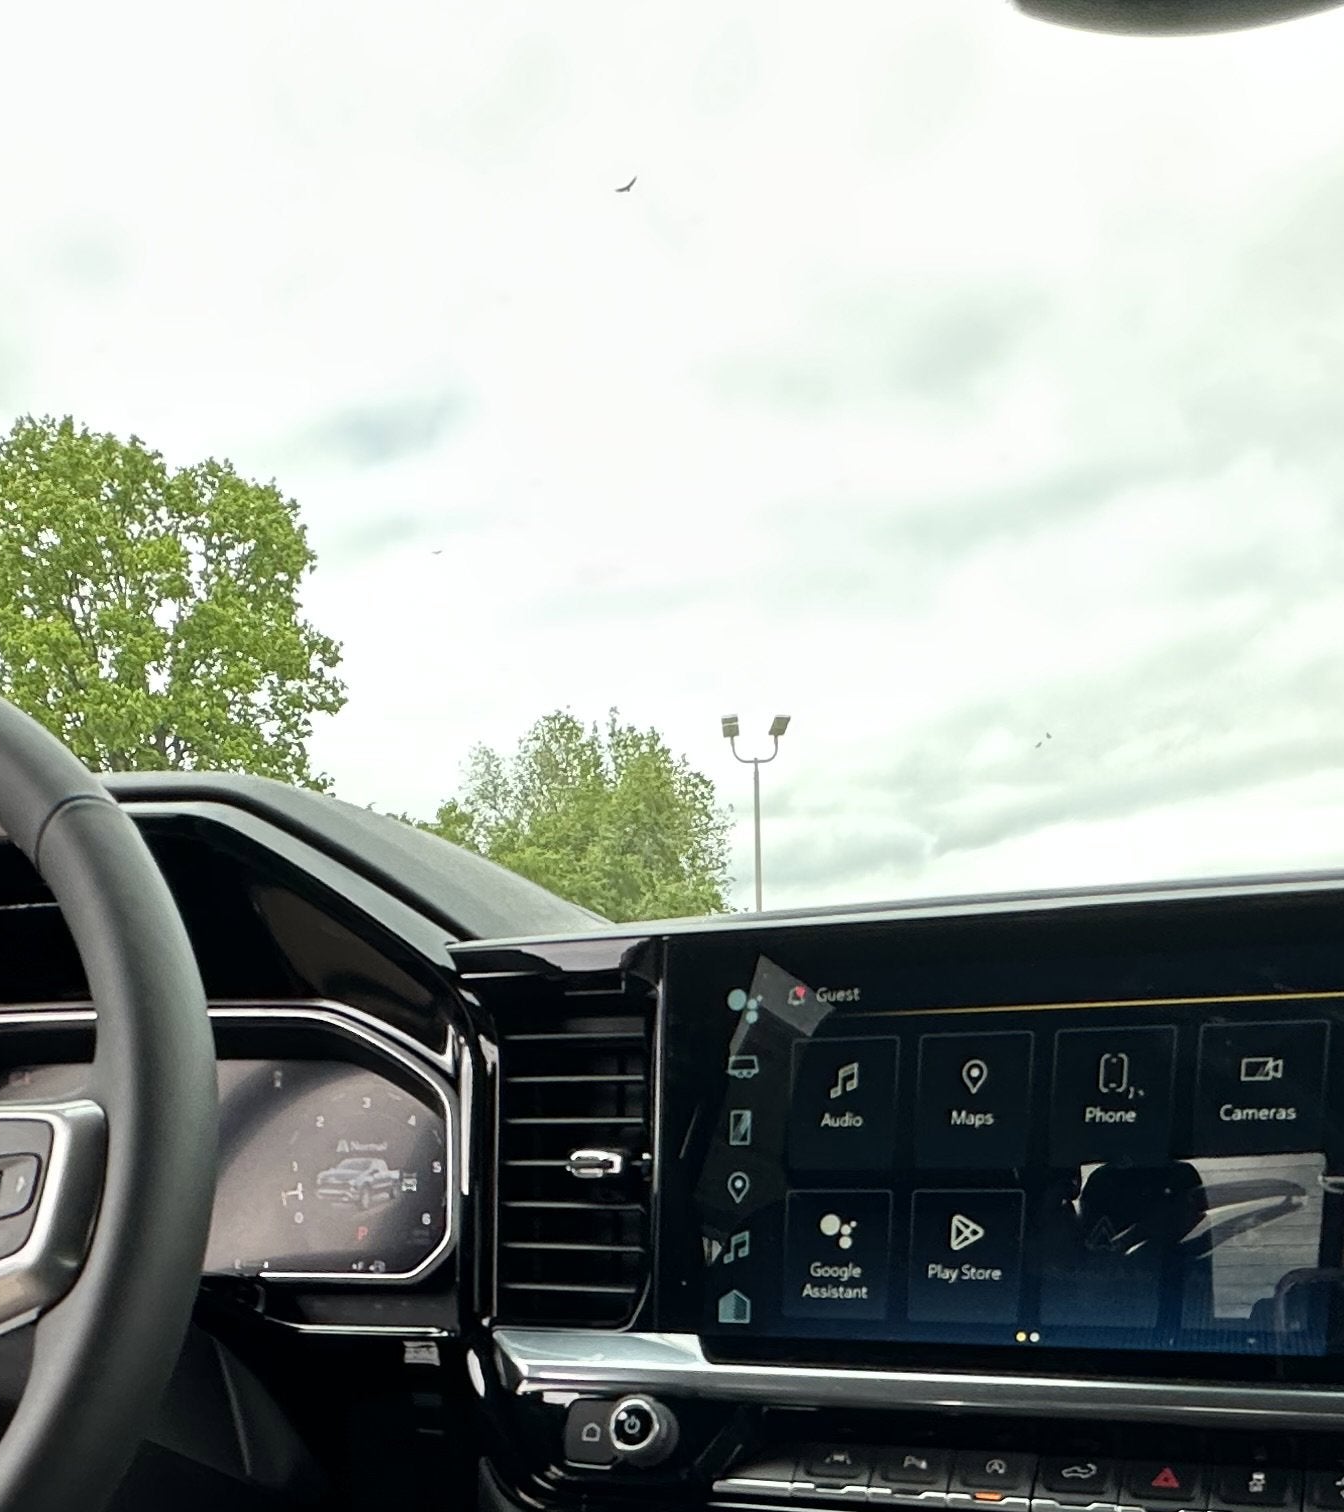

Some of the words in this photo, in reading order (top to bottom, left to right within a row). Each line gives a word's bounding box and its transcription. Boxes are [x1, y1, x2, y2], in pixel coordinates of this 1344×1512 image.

[815, 986, 861, 1003] Guest
[820, 1111, 864, 1128] Audio
[951, 1110, 994, 1129] Maps
[1085, 1106, 1137, 1125] Phone
[1219, 1104, 1297, 1122] Cameras
[357, 1227, 368, 1240] P
[810, 1262, 862, 1282] Google
[927, 1264, 959, 1283] Play
[961, 1265, 1002, 1282] Store
[801, 1283, 868, 1300] Assistant
